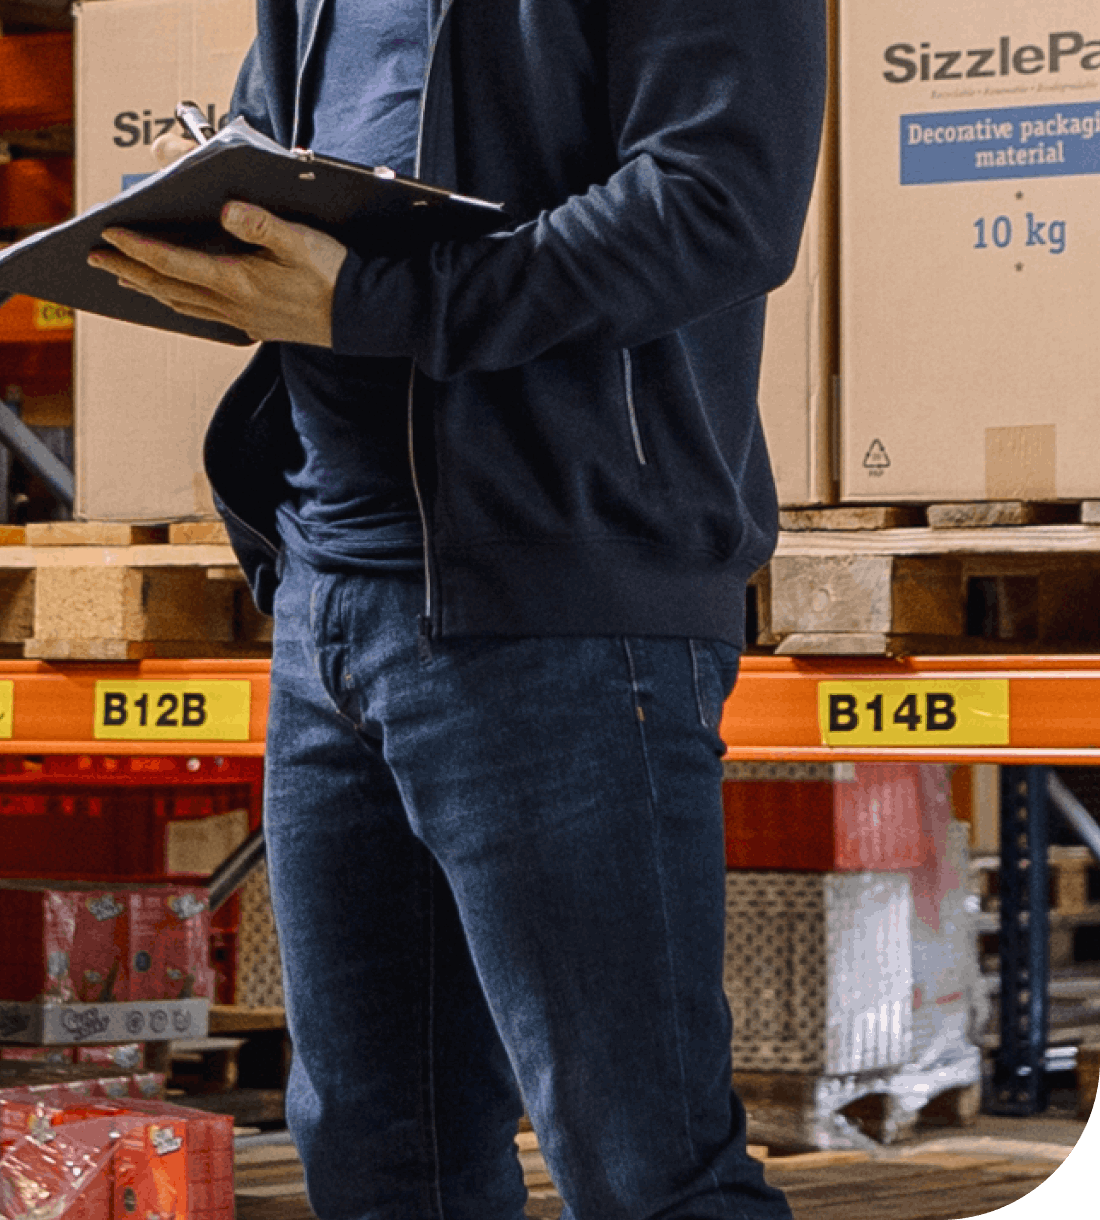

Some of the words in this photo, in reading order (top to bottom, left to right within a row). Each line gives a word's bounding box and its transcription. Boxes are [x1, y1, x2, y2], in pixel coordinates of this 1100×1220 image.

[907, 118, 1014, 145] Decorative
[974, 140, 1065, 168] material
[973, 215, 1013, 249] 10
[1024, 212, 1067, 255] kg
[102, 691, 208, 727] B12B
[828, 692, 957, 732] B14B
